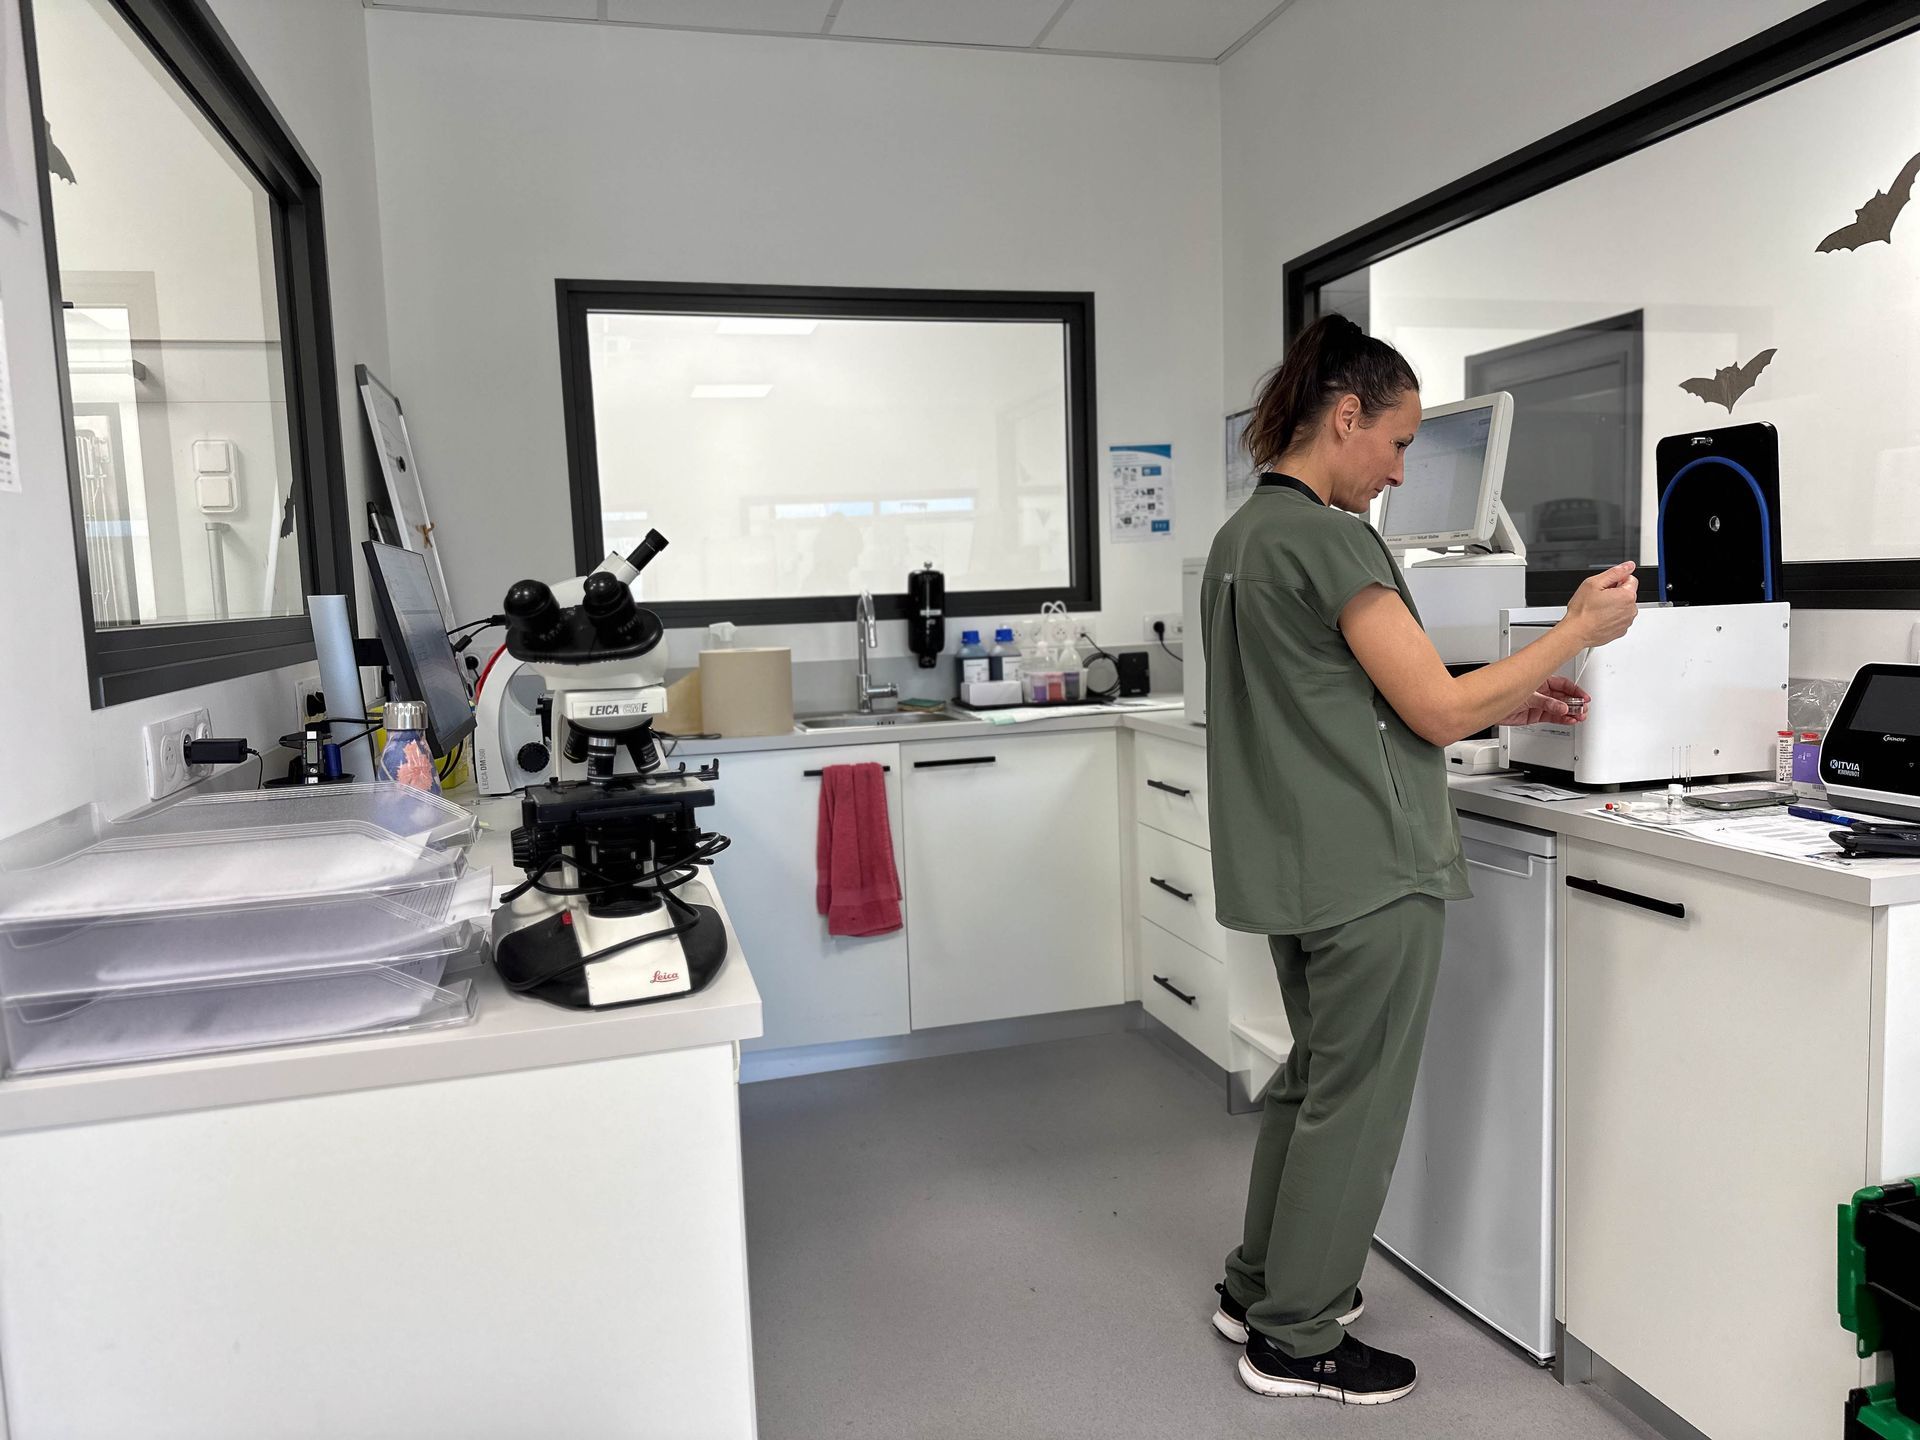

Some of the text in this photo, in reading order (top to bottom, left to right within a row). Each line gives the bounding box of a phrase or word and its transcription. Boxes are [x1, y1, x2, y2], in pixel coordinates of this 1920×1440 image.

[589, 704, 619, 716] LEICA
[1829, 759, 1860, 772] KITVIA
[481, 771, 489, 790] LEICA
[650, 970, 679, 983] Leica
